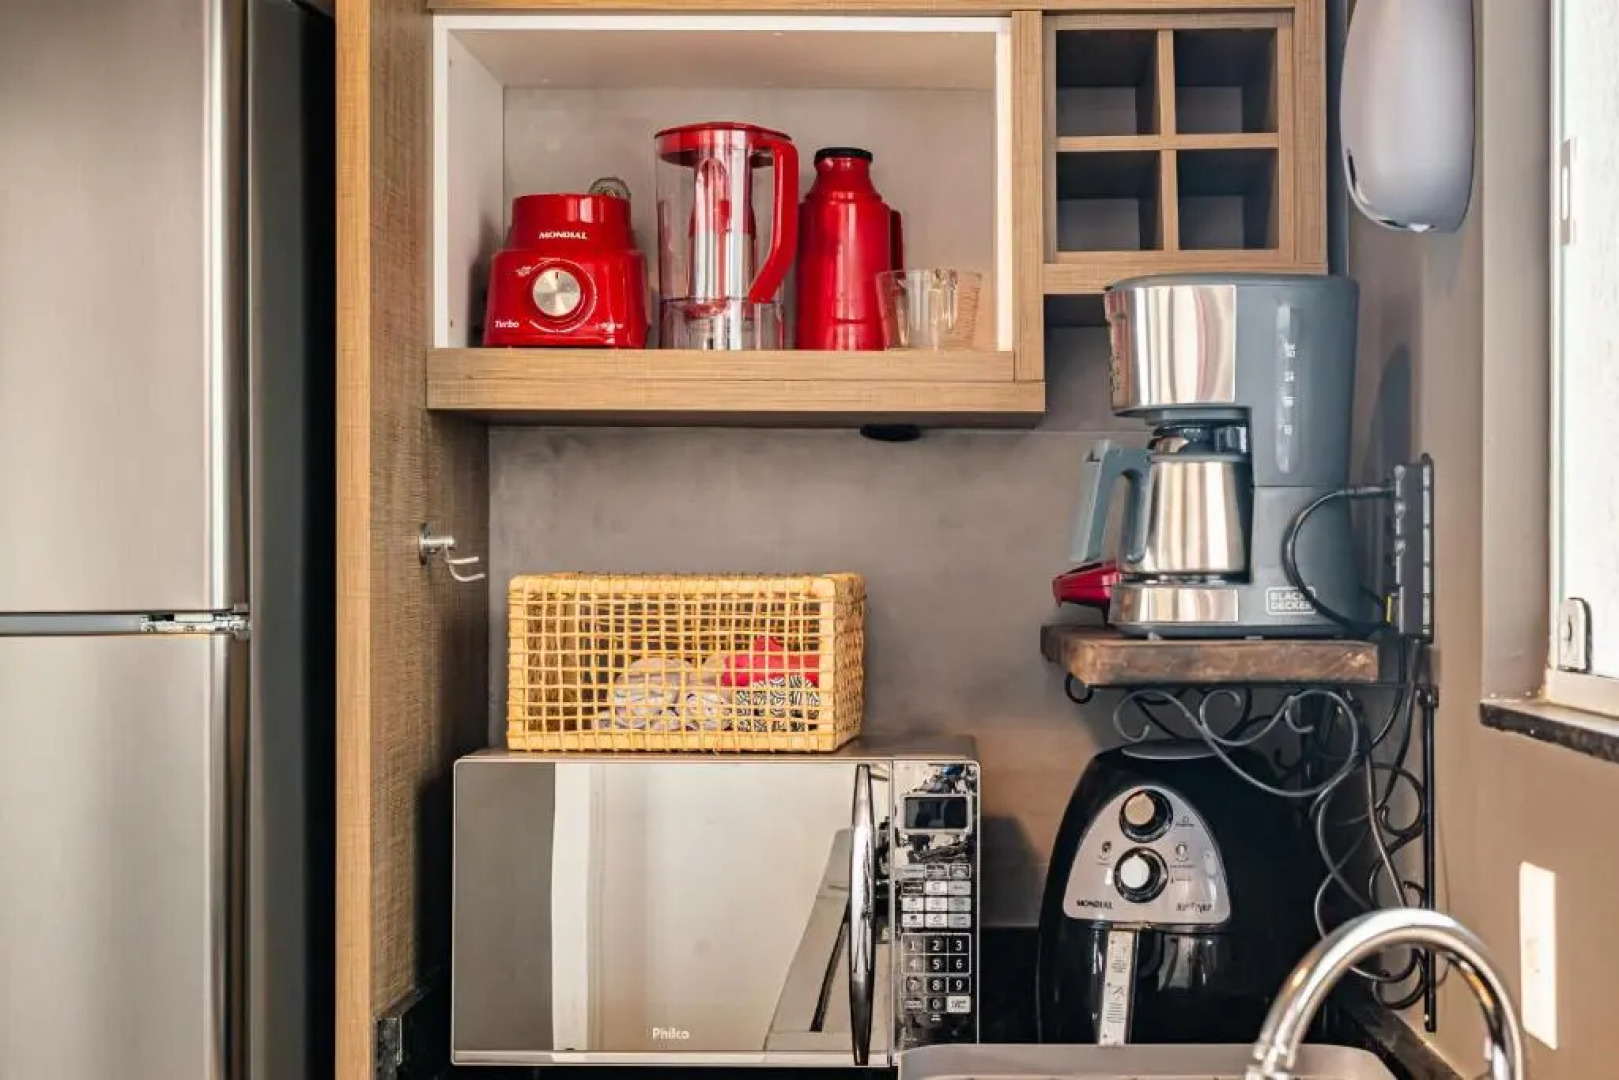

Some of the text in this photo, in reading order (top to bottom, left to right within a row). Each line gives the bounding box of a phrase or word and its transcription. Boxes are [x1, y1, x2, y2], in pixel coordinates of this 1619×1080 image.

[538, 230, 588, 240] MONDIAL
[494, 319, 519, 329] Turbo
[910, 940, 962, 951] 1 2 3
[932, 959, 940, 970] 5
[956, 959, 963, 970] 6
[932, 979, 940, 991] 8
[956, 979, 962, 991] 9
[932, 998, 940, 1010] 0
[652, 1027, 690, 1040] Philco
